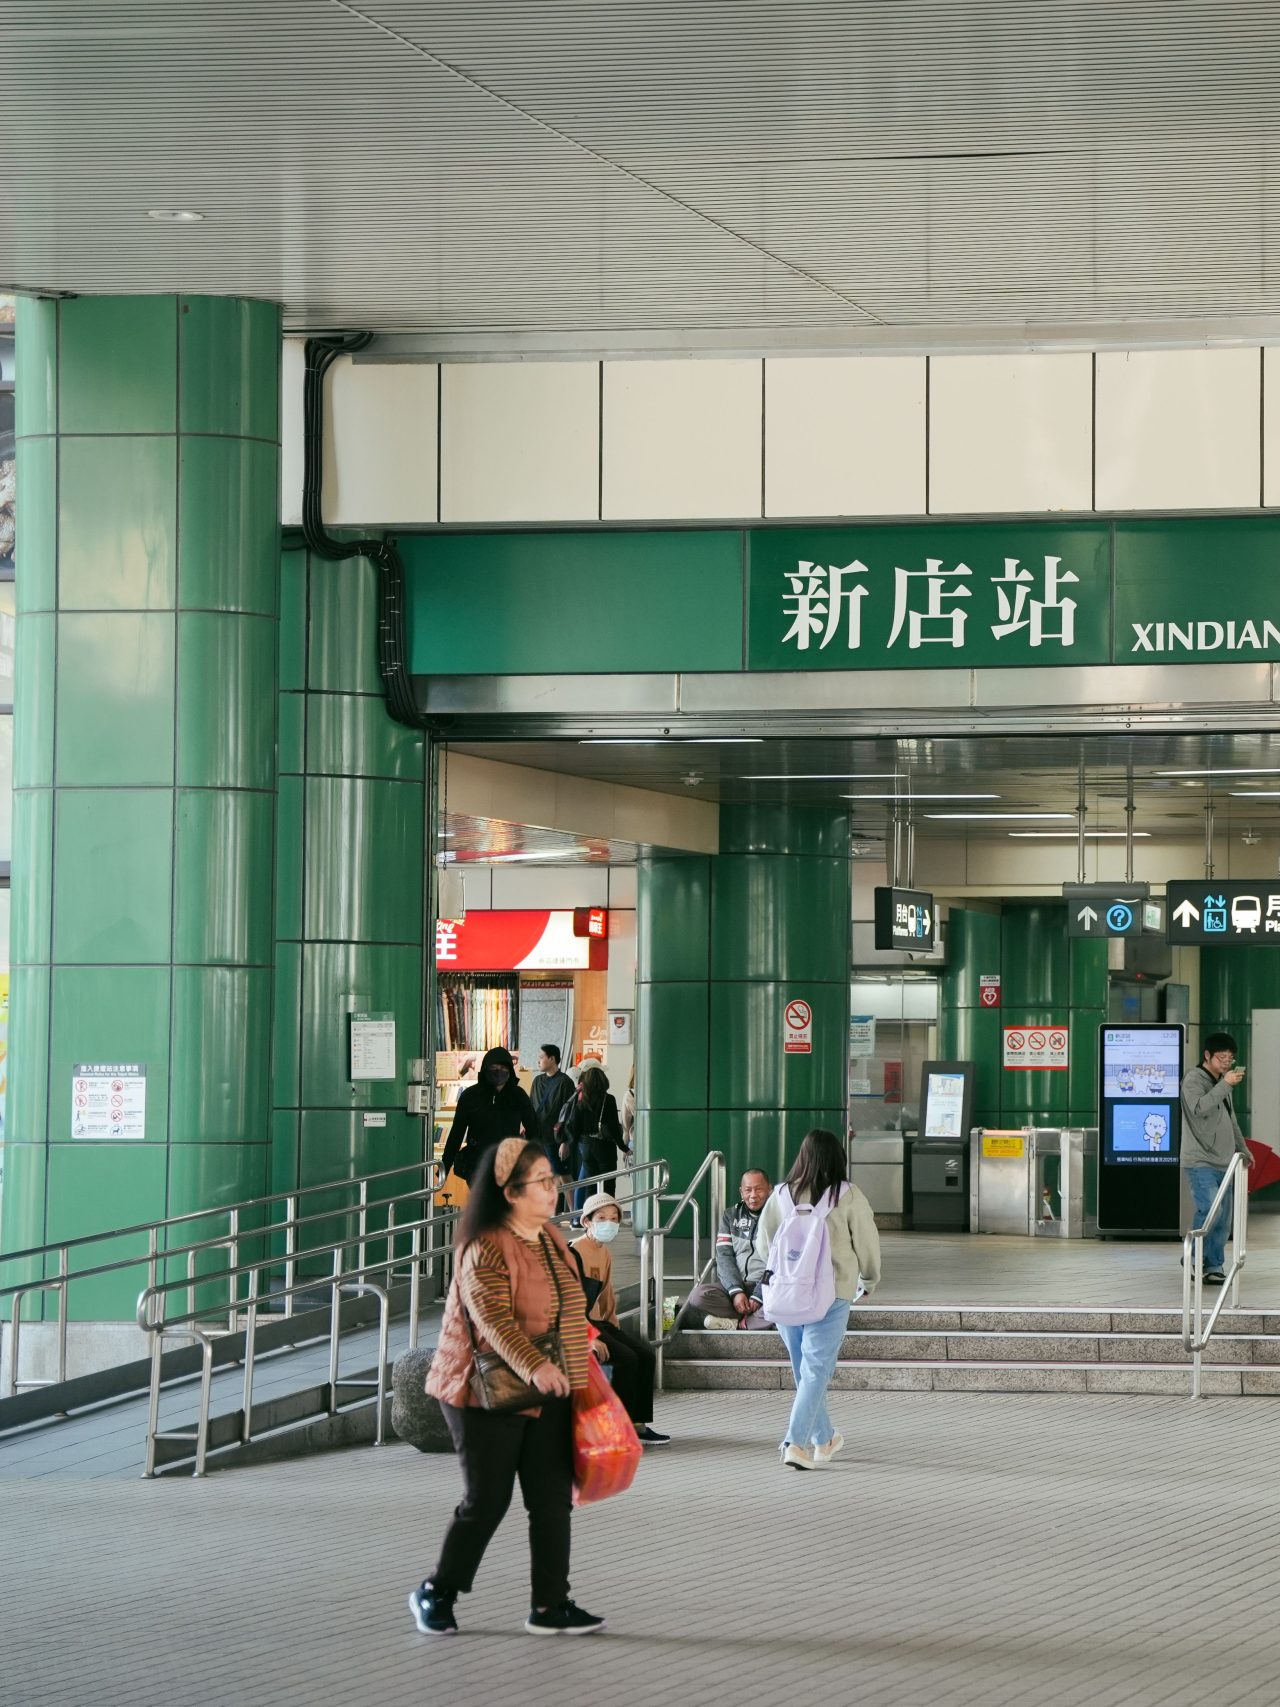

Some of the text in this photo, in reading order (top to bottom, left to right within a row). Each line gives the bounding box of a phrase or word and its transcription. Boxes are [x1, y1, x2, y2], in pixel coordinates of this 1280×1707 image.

[781, 555, 1081, 650] 新店站
[895, 903, 908, 923] 月台
